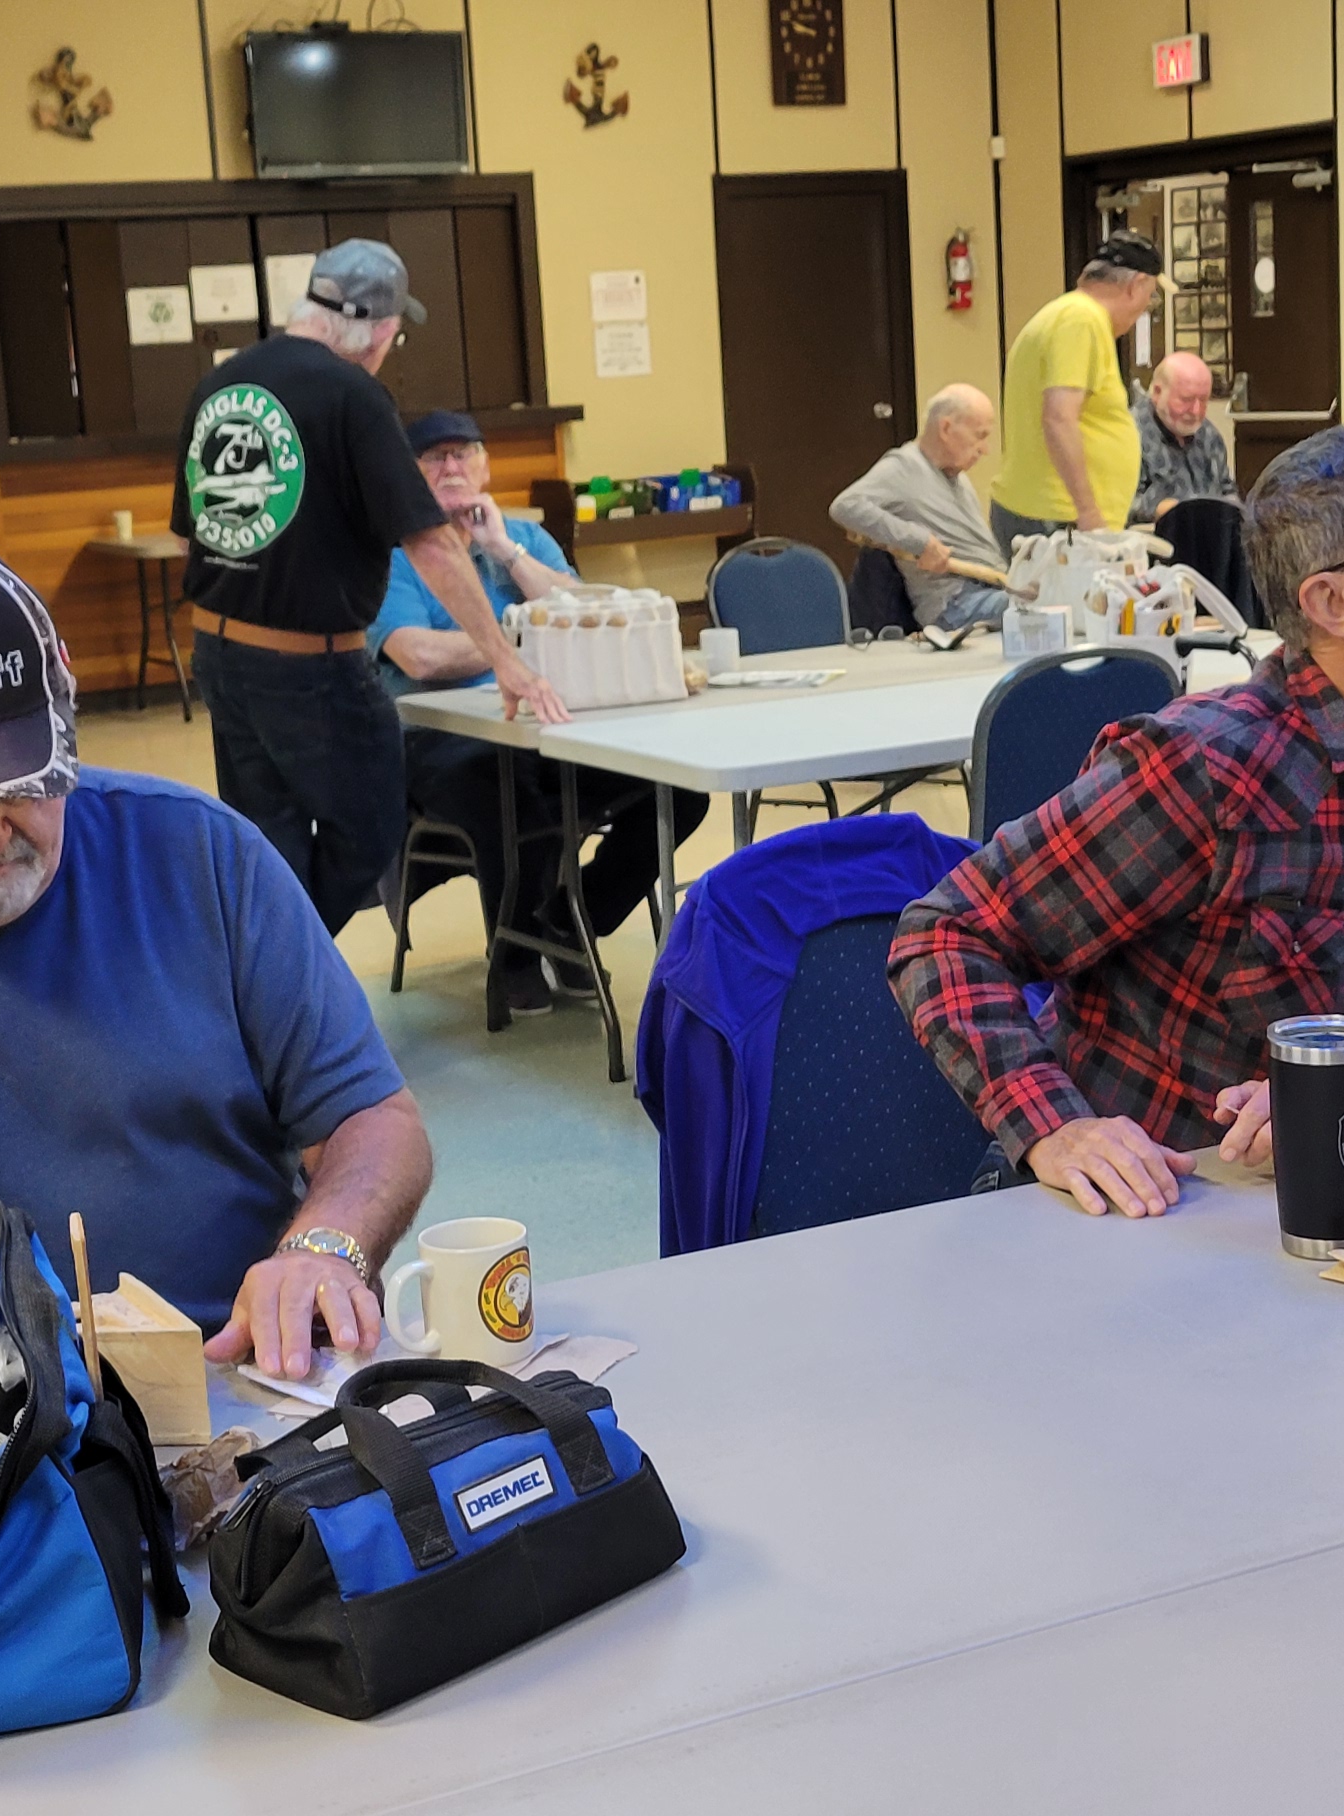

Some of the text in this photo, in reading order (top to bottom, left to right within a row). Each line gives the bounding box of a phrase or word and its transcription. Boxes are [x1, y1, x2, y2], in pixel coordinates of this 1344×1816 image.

[188, 391, 298, 470] DOUGLAS DC-3
[465, 1470, 545, 1517] DREMEL
